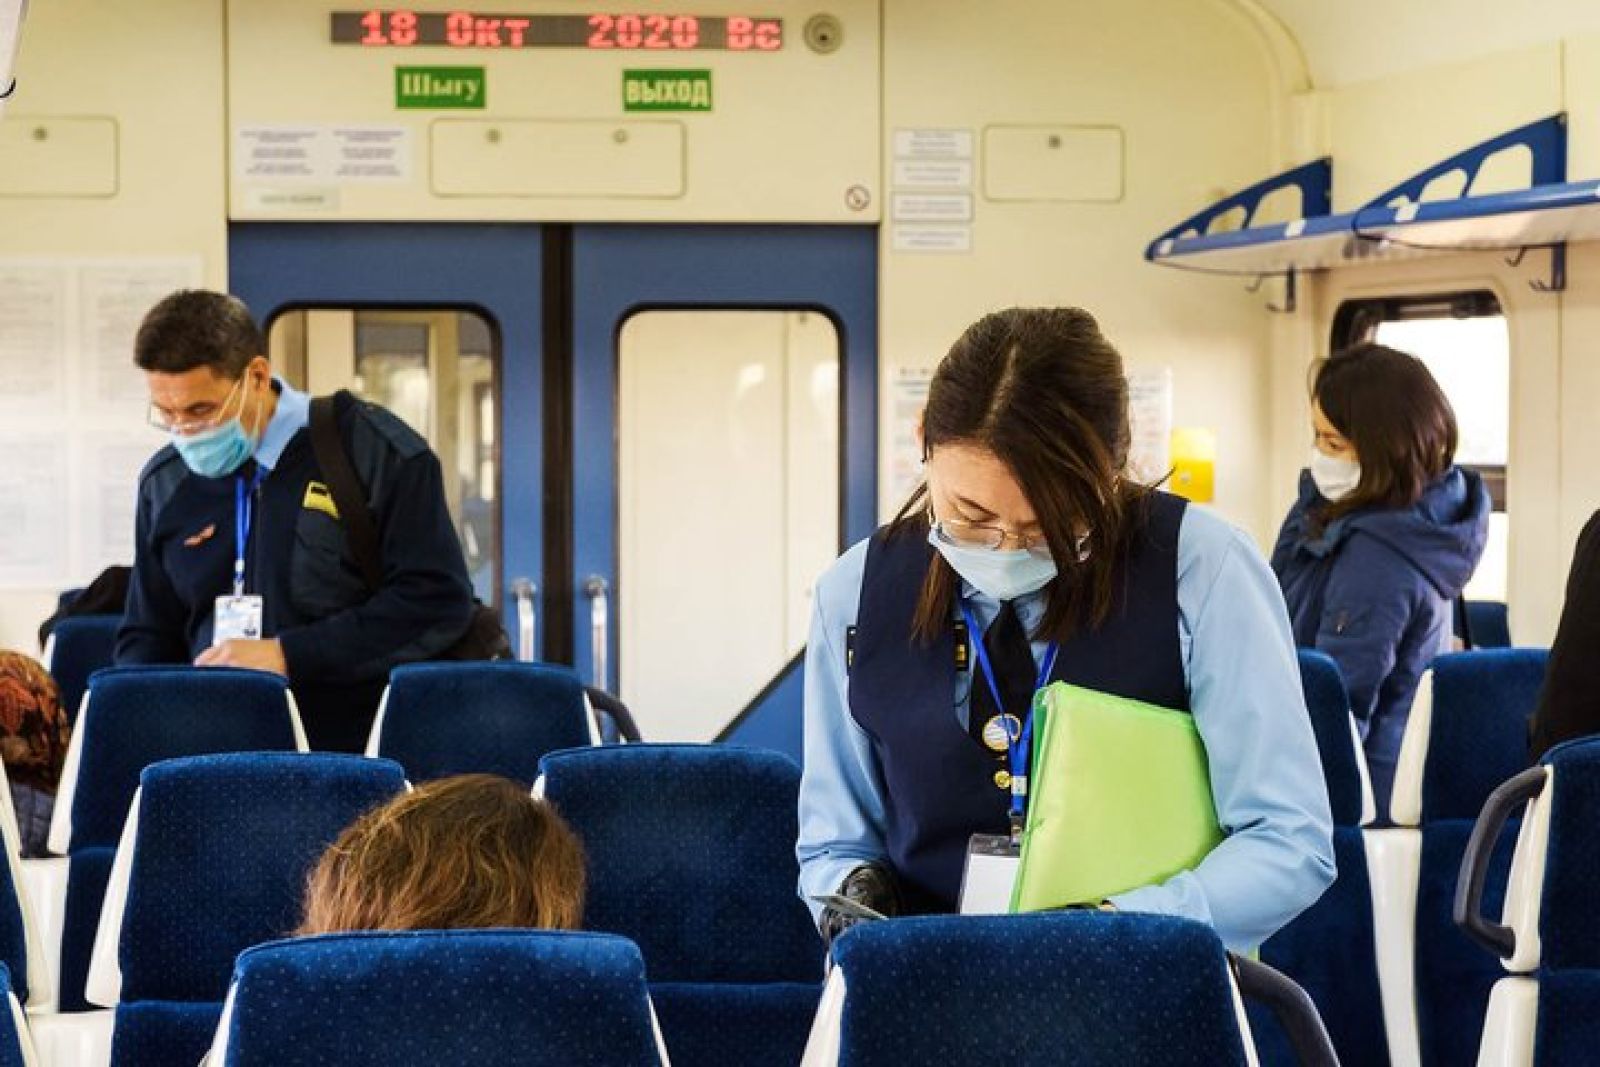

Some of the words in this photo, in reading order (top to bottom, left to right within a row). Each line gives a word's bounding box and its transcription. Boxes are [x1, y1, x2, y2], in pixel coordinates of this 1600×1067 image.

[360, 10, 418, 46] 18
[446, 12, 530, 47] Окт
[588, 14, 699, 49] 2020
[727, 16, 781, 50] Вс
[625, 80, 711, 107] ВЫХОД
